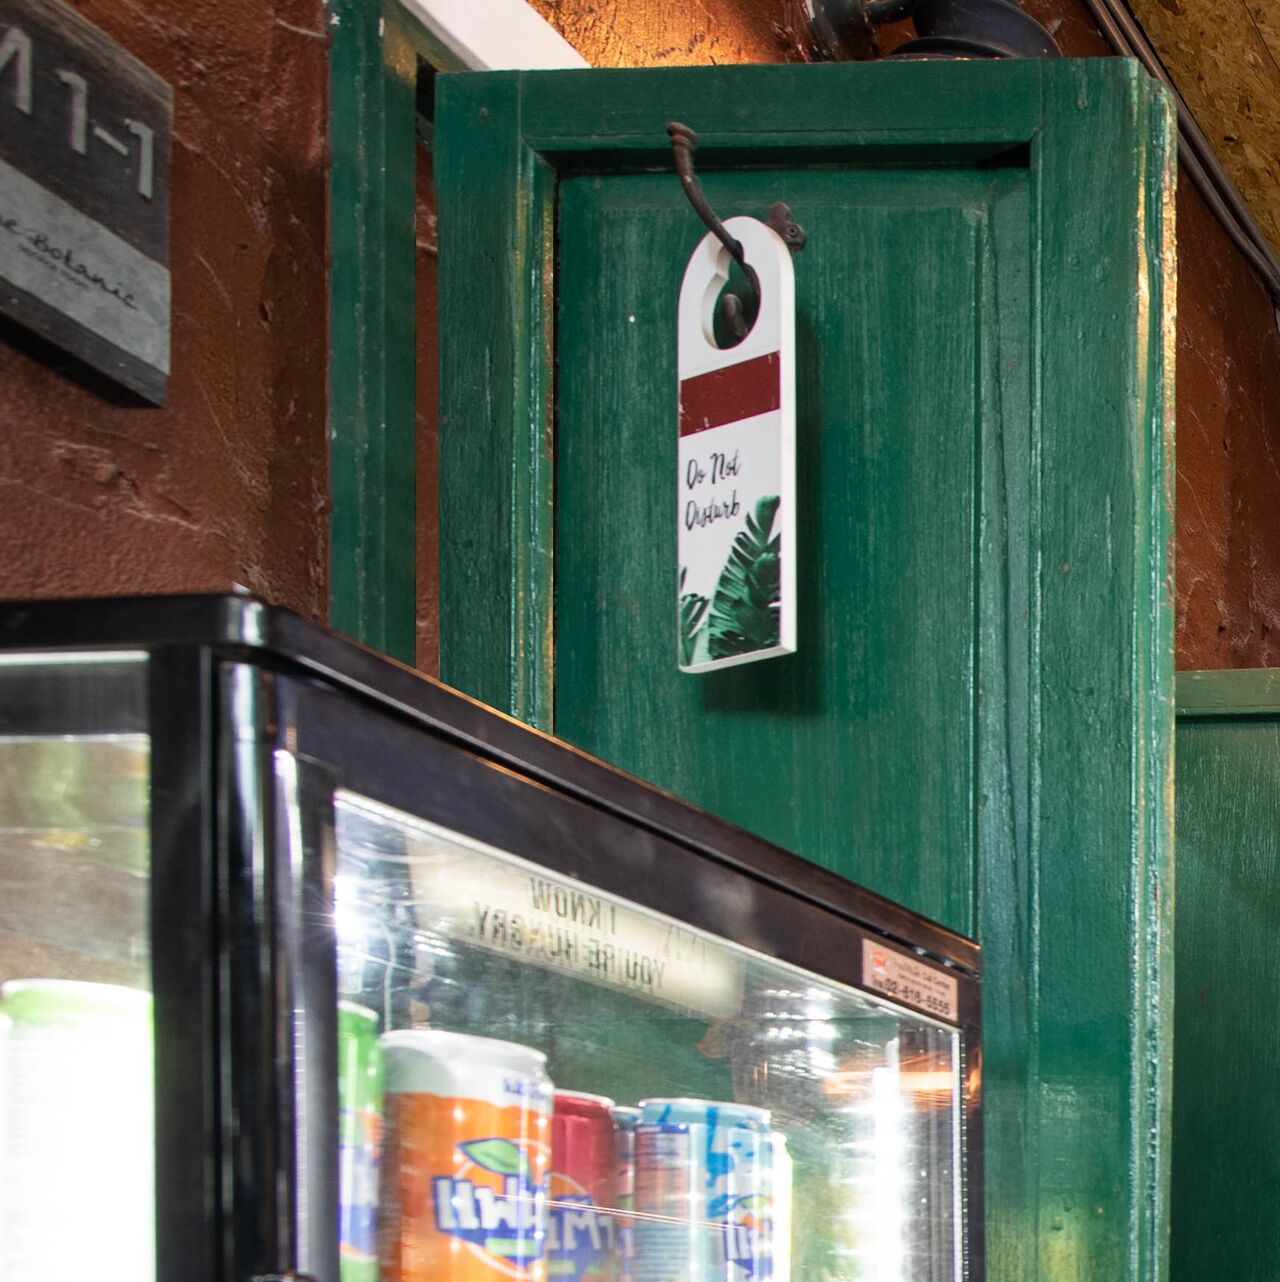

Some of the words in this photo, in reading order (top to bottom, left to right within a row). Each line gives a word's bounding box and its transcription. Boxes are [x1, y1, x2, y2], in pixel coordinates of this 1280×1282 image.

[687, 458, 706, 490] Do
[709, 448, 739, 485] Not
[686, 489, 740, 531] Disturb
